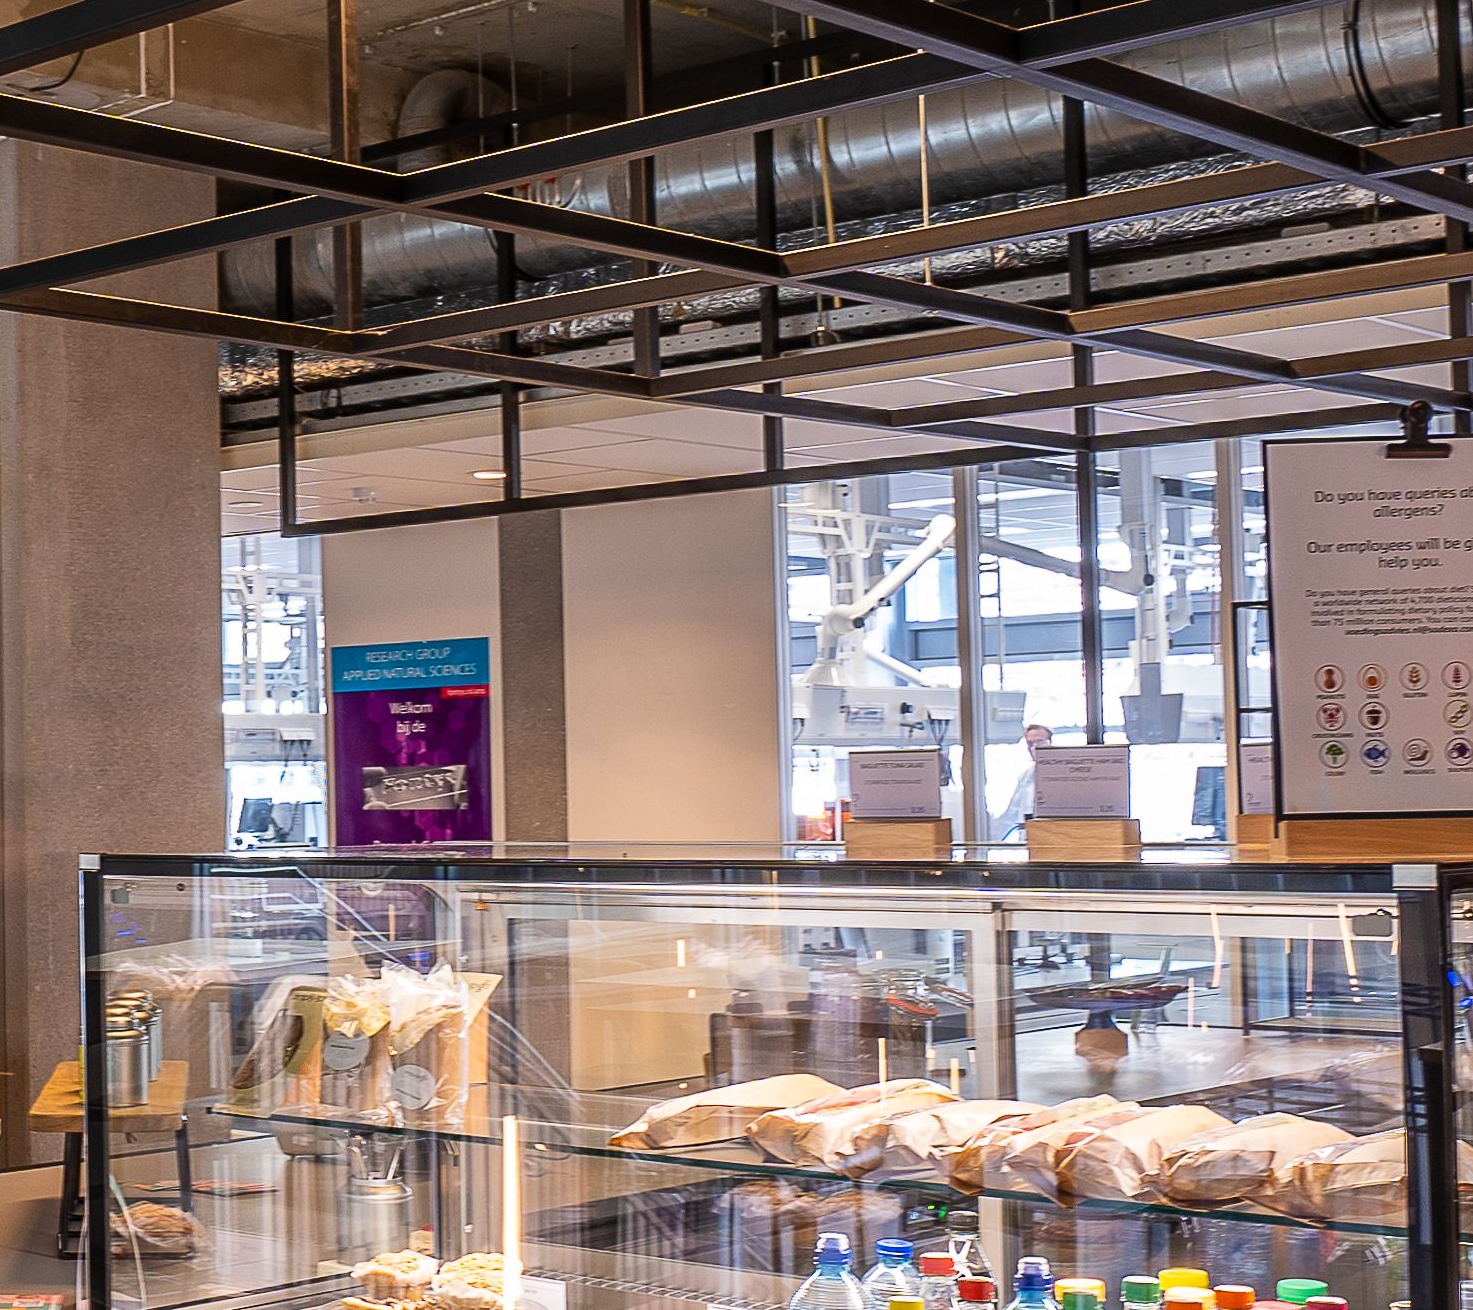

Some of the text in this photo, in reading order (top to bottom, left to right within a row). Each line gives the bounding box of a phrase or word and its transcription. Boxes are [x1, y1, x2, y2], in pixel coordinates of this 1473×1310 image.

[1313, 490, 1334, 503] Do
[1338, 491, 1364, 504] you
[1367, 489, 1401, 501] have
[1405, 487, 1456, 502] queries
[1373, 504, 1444, 519] allergens?
[1307, 541, 1333, 553] Our
[1337, 539, 1413, 554] employees
[1416, 538, 1440, 550] will
[1443, 538, 1461, 549] be
[1378, 556, 1443, 570] help you.
[365, 647, 451, 663] RESEARCH GROUP
[342, 662, 477, 681] APPLIED NATURAL SCIENCES
[389, 702, 433, 715] Welkom
[396, 721, 426, 735] bij de
